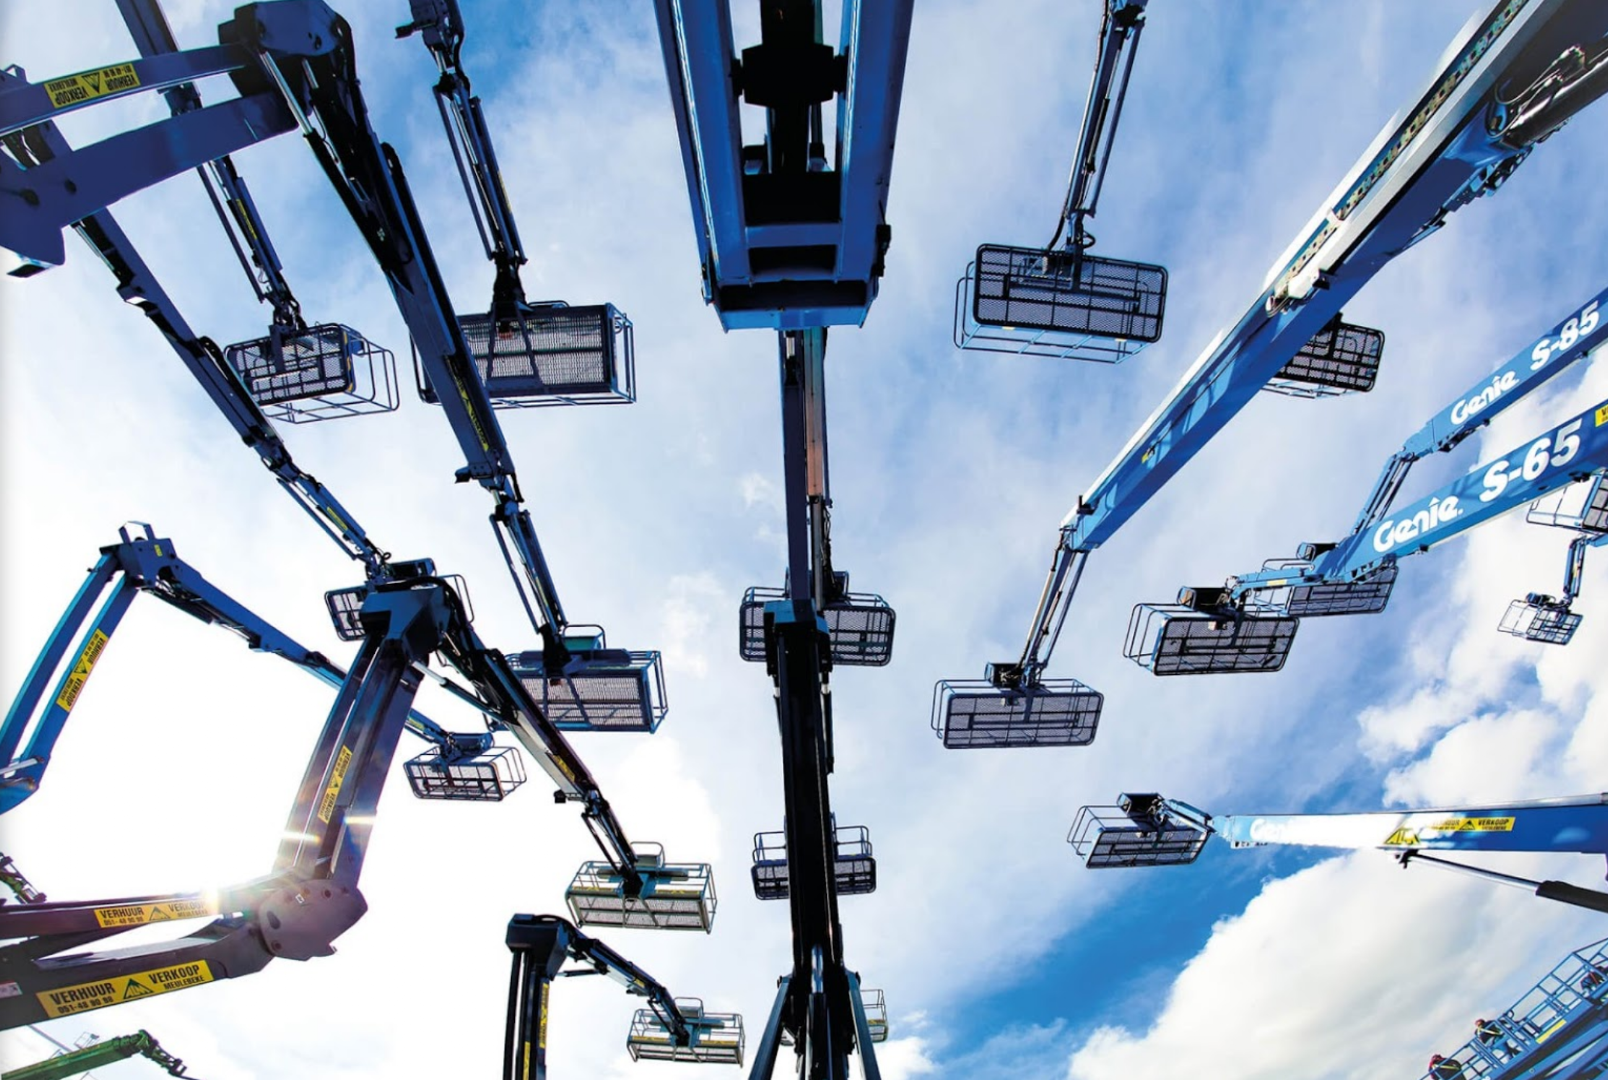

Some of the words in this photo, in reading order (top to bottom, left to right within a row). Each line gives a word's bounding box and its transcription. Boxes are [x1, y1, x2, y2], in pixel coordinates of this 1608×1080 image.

[55, 86, 90, 105] VERKOOP
[1451, 371, 1519, 425] Genie
[1530, 300, 1599, 371] S-85
[1373, 496, 1460, 553] Genie
[1479, 418, 1583, 503] S-65
[99, 907, 144, 919] VERHUUR
[50, 982, 116, 1005] VERHUUR
[148, 964, 200, 984] VERKOOP
[163, 975, 205, 990] MEULEBEKE
